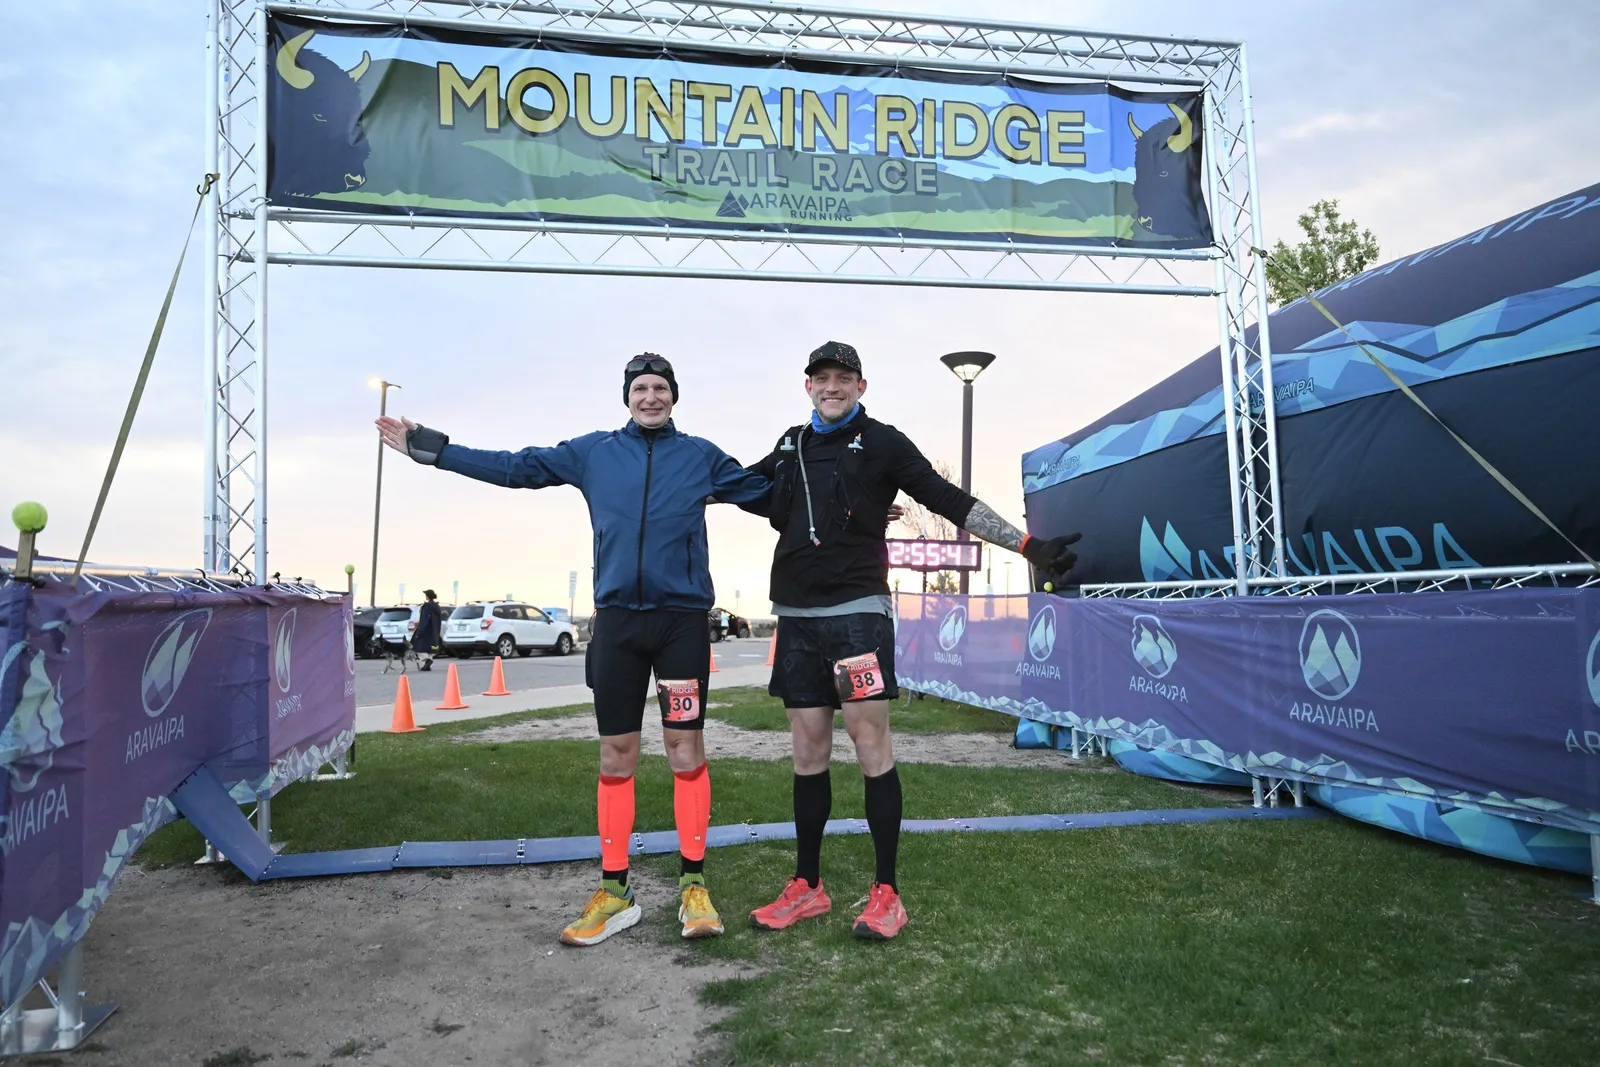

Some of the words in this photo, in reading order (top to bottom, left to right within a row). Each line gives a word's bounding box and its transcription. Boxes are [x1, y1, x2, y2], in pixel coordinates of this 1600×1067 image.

[436, 61, 850, 153] MOUNTAIN
[874, 94, 1087, 167] RIDGE
[642, 145, 790, 188] TRAIL
[811, 156, 939, 197] RACE
[749, 192, 851, 213] ARAVAIPA
[790, 209, 853, 223] RUNNING
[1248, 376, 1315, 409] ARVAIPA
[853, 671, 875, 689] 38
[1015, 661, 1061, 681] ARAVAIPA
[672, 697, 693, 711] 30
[1289, 701, 1380, 733] ARAVAIPA
[125, 714, 185, 764] ARAVAIPA
